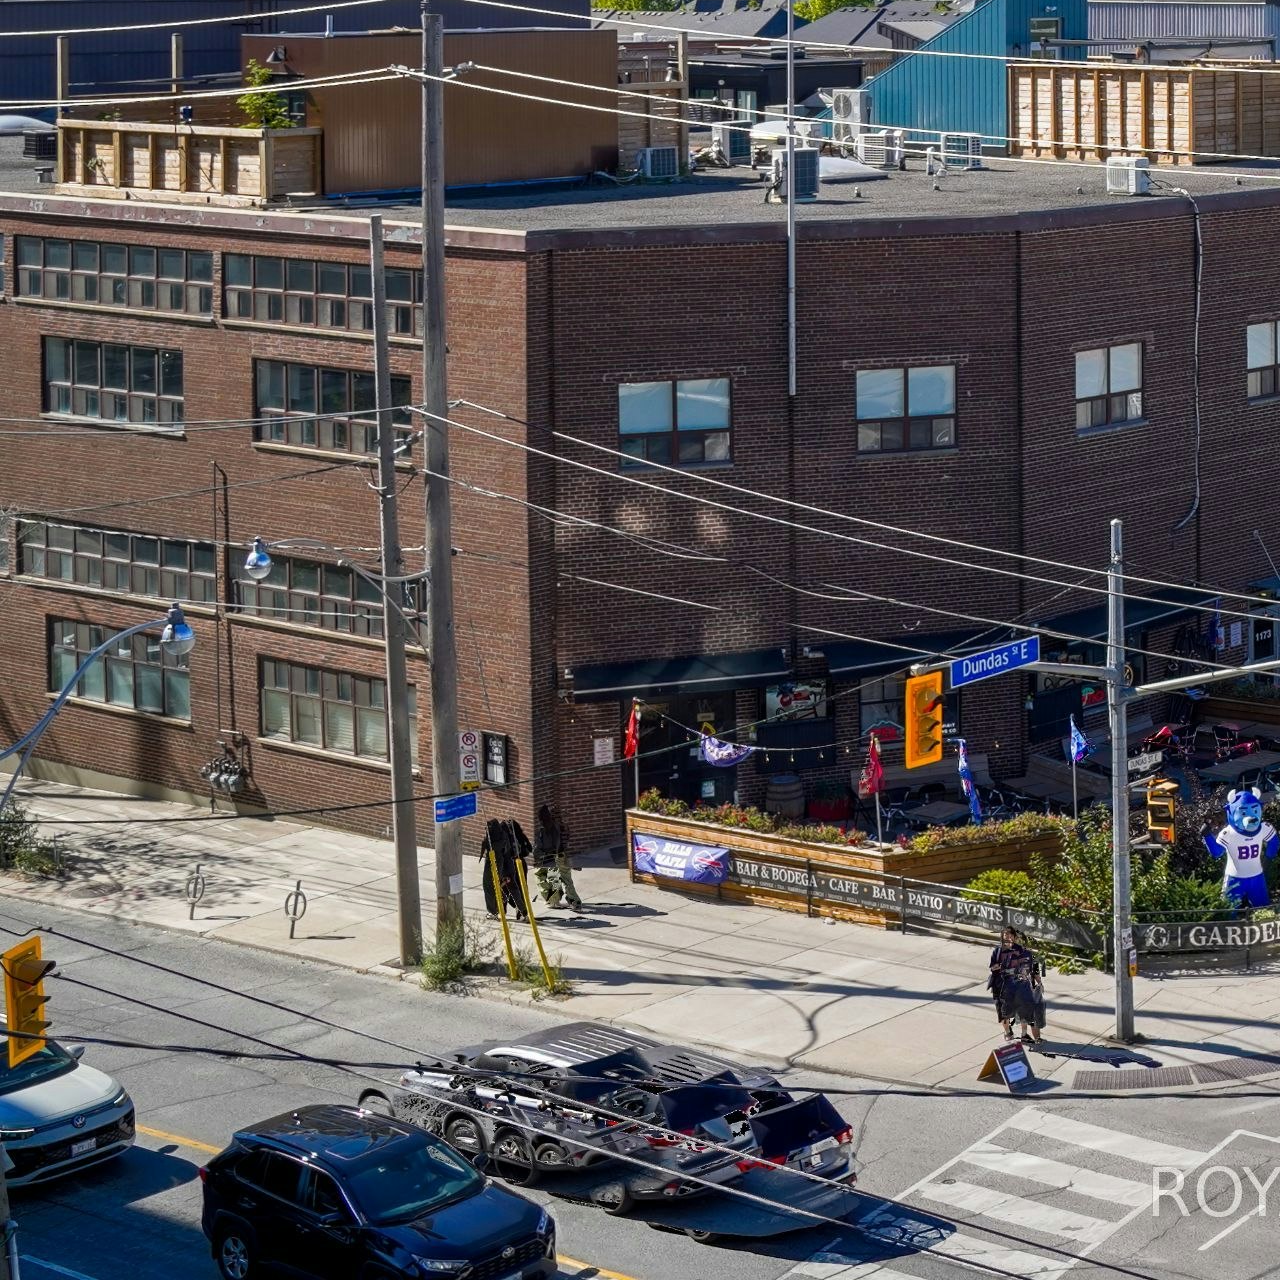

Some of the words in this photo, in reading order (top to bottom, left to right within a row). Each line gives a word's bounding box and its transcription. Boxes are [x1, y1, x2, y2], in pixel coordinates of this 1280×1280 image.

[1255, 629, 1272, 642] 1173
[962, 650, 1009, 678] Dundas
[1011, 646, 1019, 656] St
[1020, 642, 1028, 660] E
[735, 860, 759, 878] BAR
[760, 866, 770, 879] &
[771, 867, 818, 888] BODEGA
[829, 878, 859, 895] CAFE
[872, 885, 896, 902] BAR
[907, 892, 943, 911] PATIO
[956, 901, 1003, 922] EVENTS
